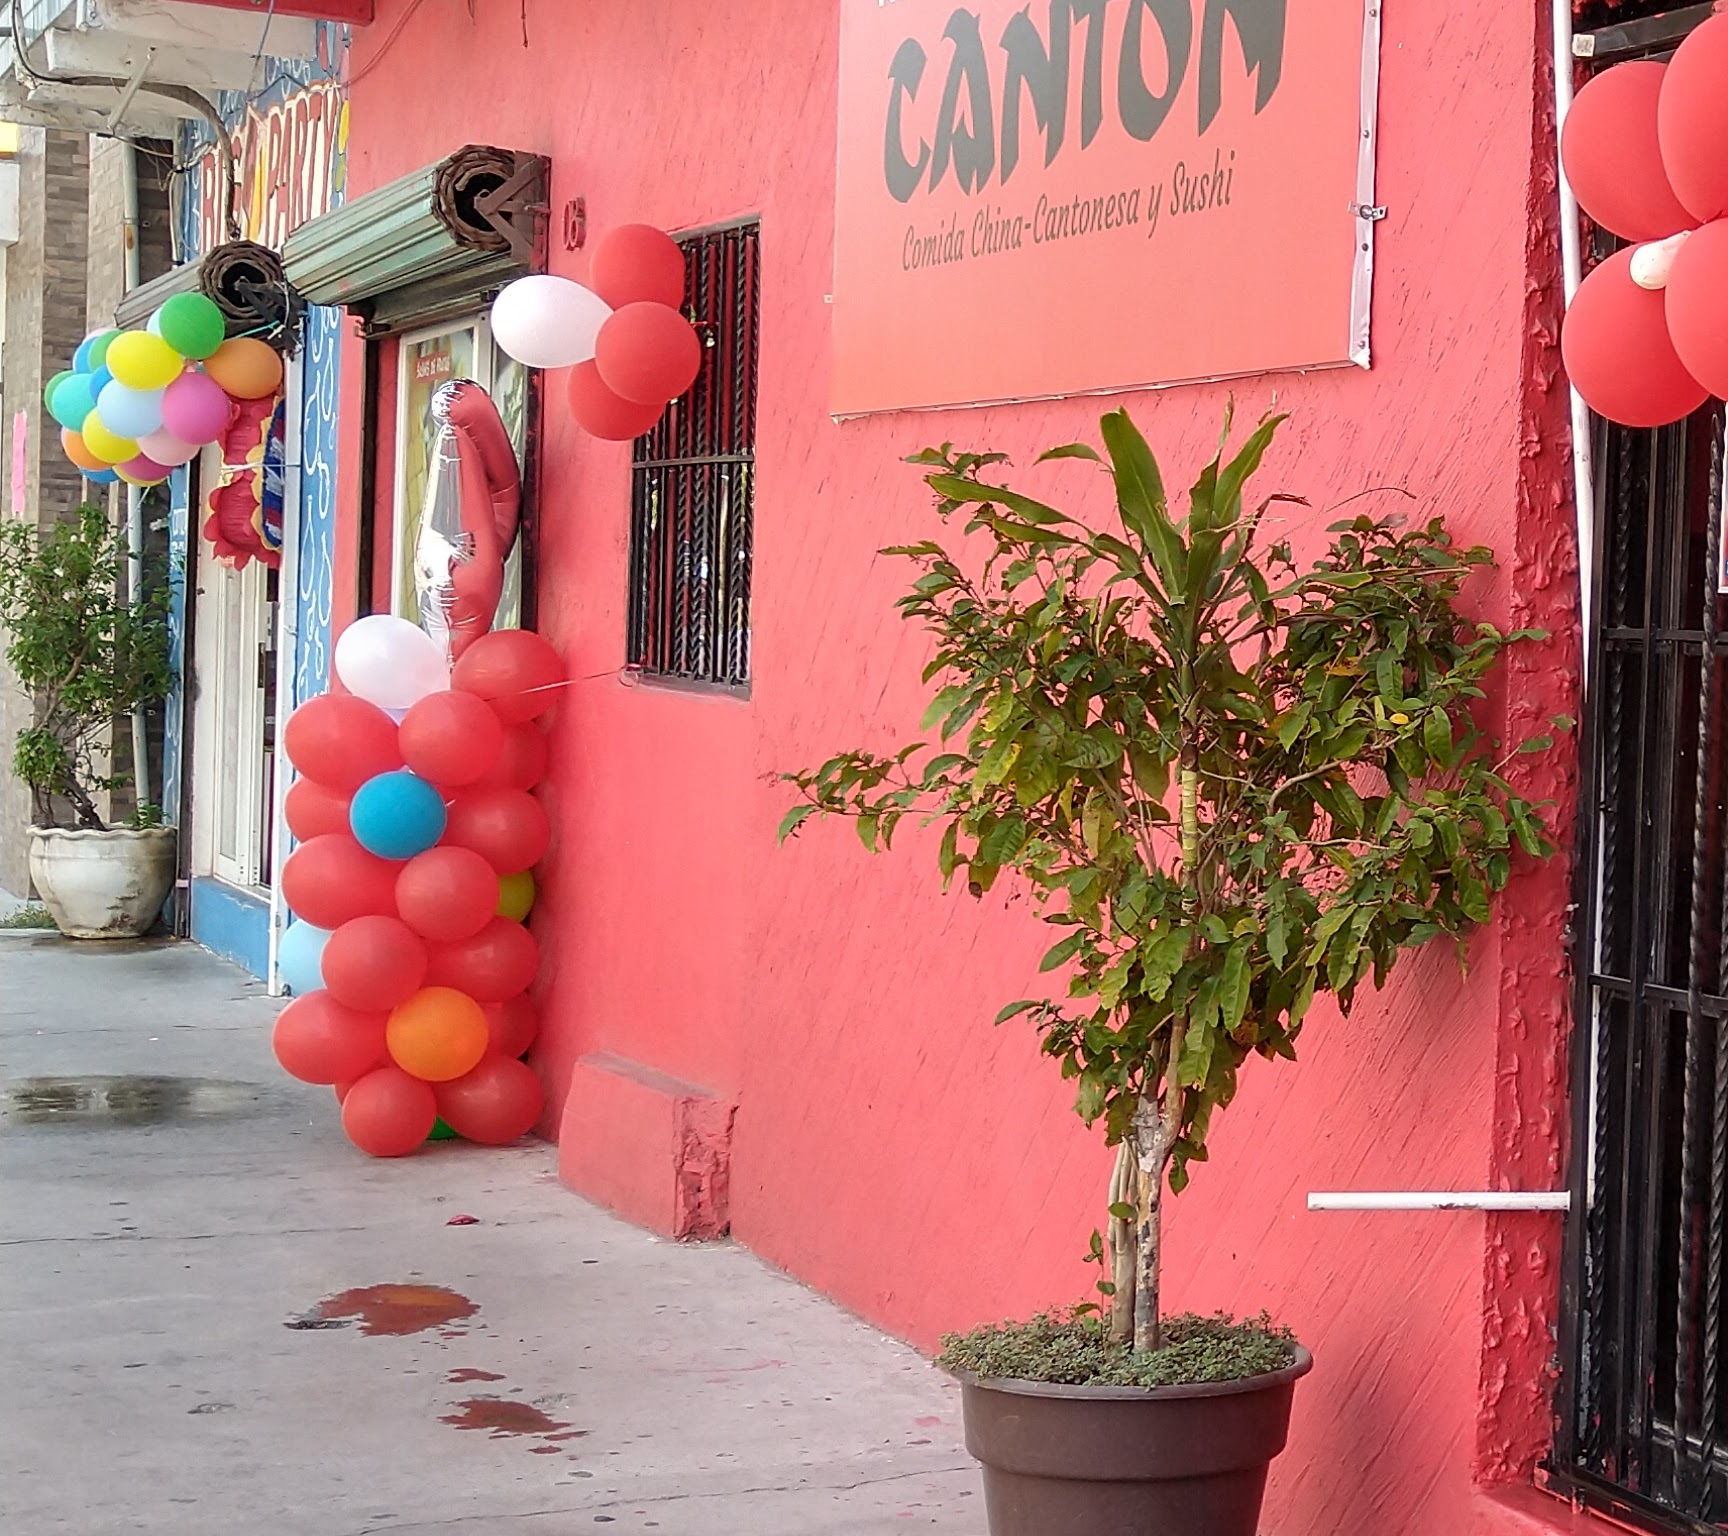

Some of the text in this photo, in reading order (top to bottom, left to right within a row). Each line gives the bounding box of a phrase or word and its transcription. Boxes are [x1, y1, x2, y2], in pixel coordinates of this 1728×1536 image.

[264, 84, 339, 251] PARTY
[902, 147, 1236, 272] Comida China-Cantonesa y Sushi
